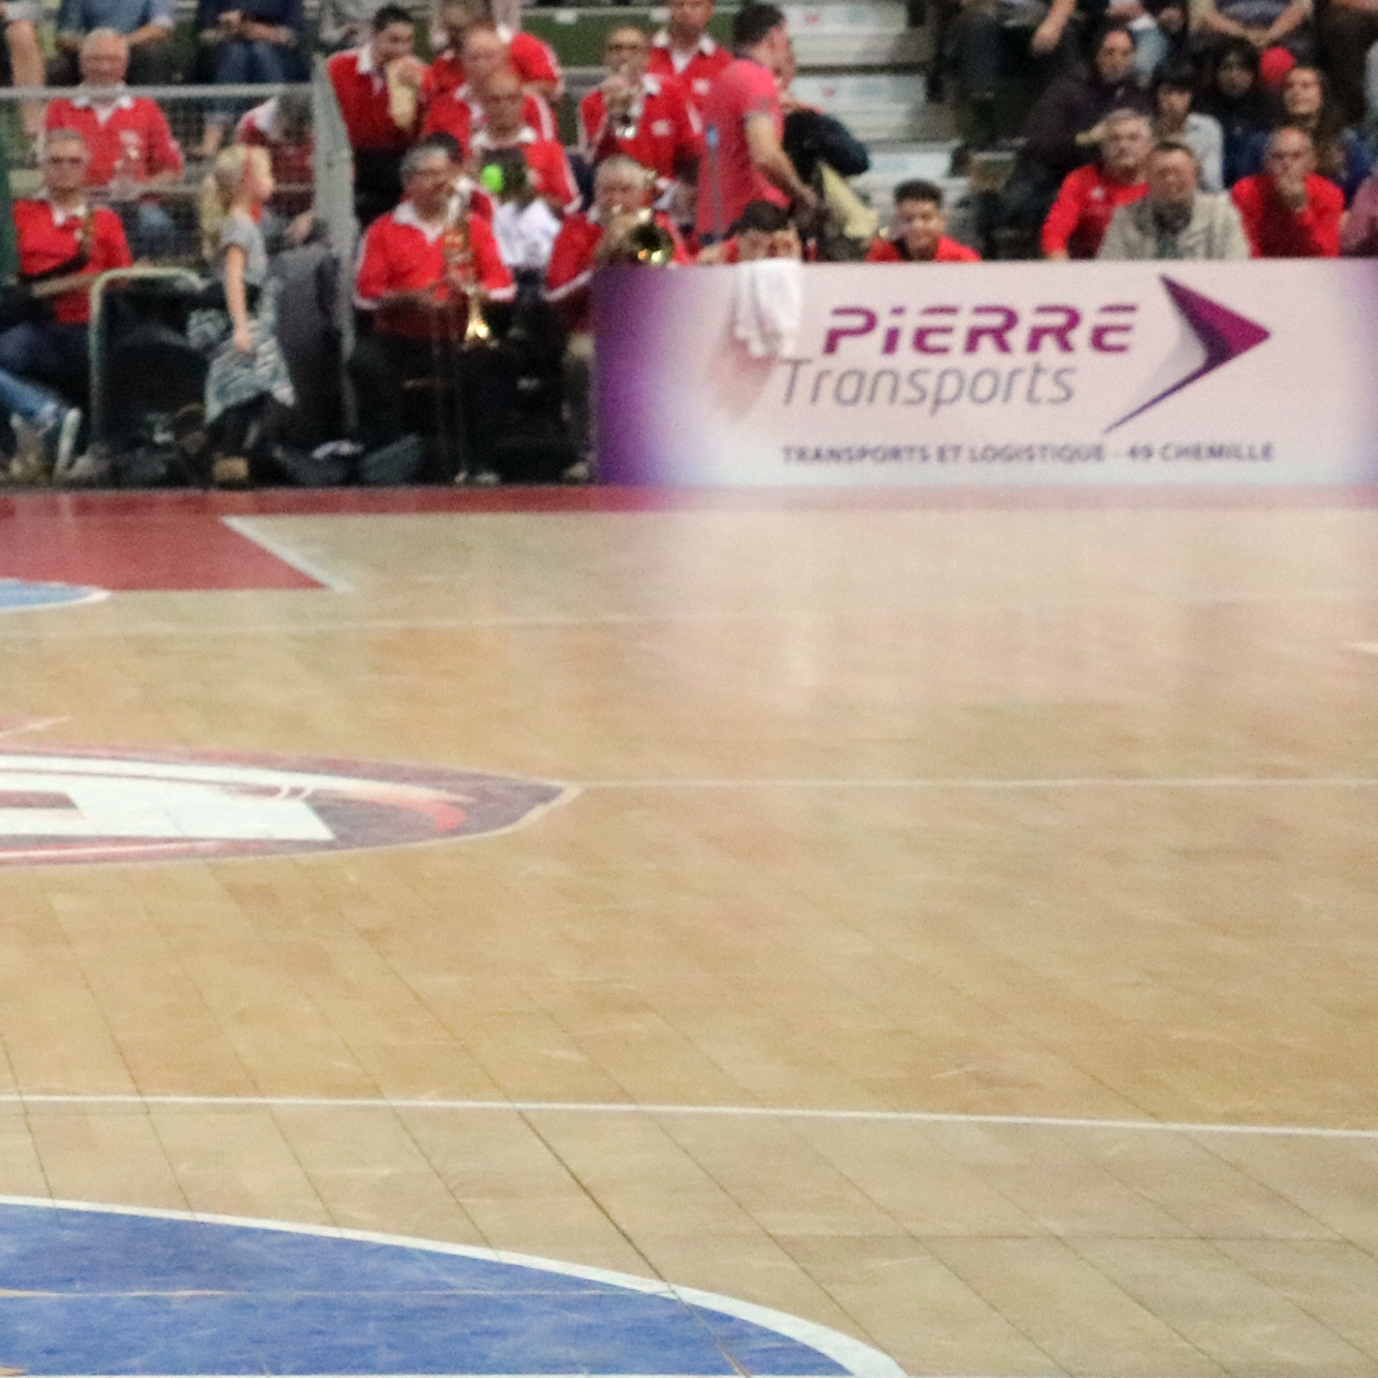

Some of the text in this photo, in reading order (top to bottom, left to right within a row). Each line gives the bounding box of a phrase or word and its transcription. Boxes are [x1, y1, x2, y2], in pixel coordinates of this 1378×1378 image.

[778, 357, 1077, 417] Transports
[782, 443, 930, 464] TRANSPORTS
[936, 443, 963, 464] ET
[968, 442, 1104, 464] LOGISTIQUE
